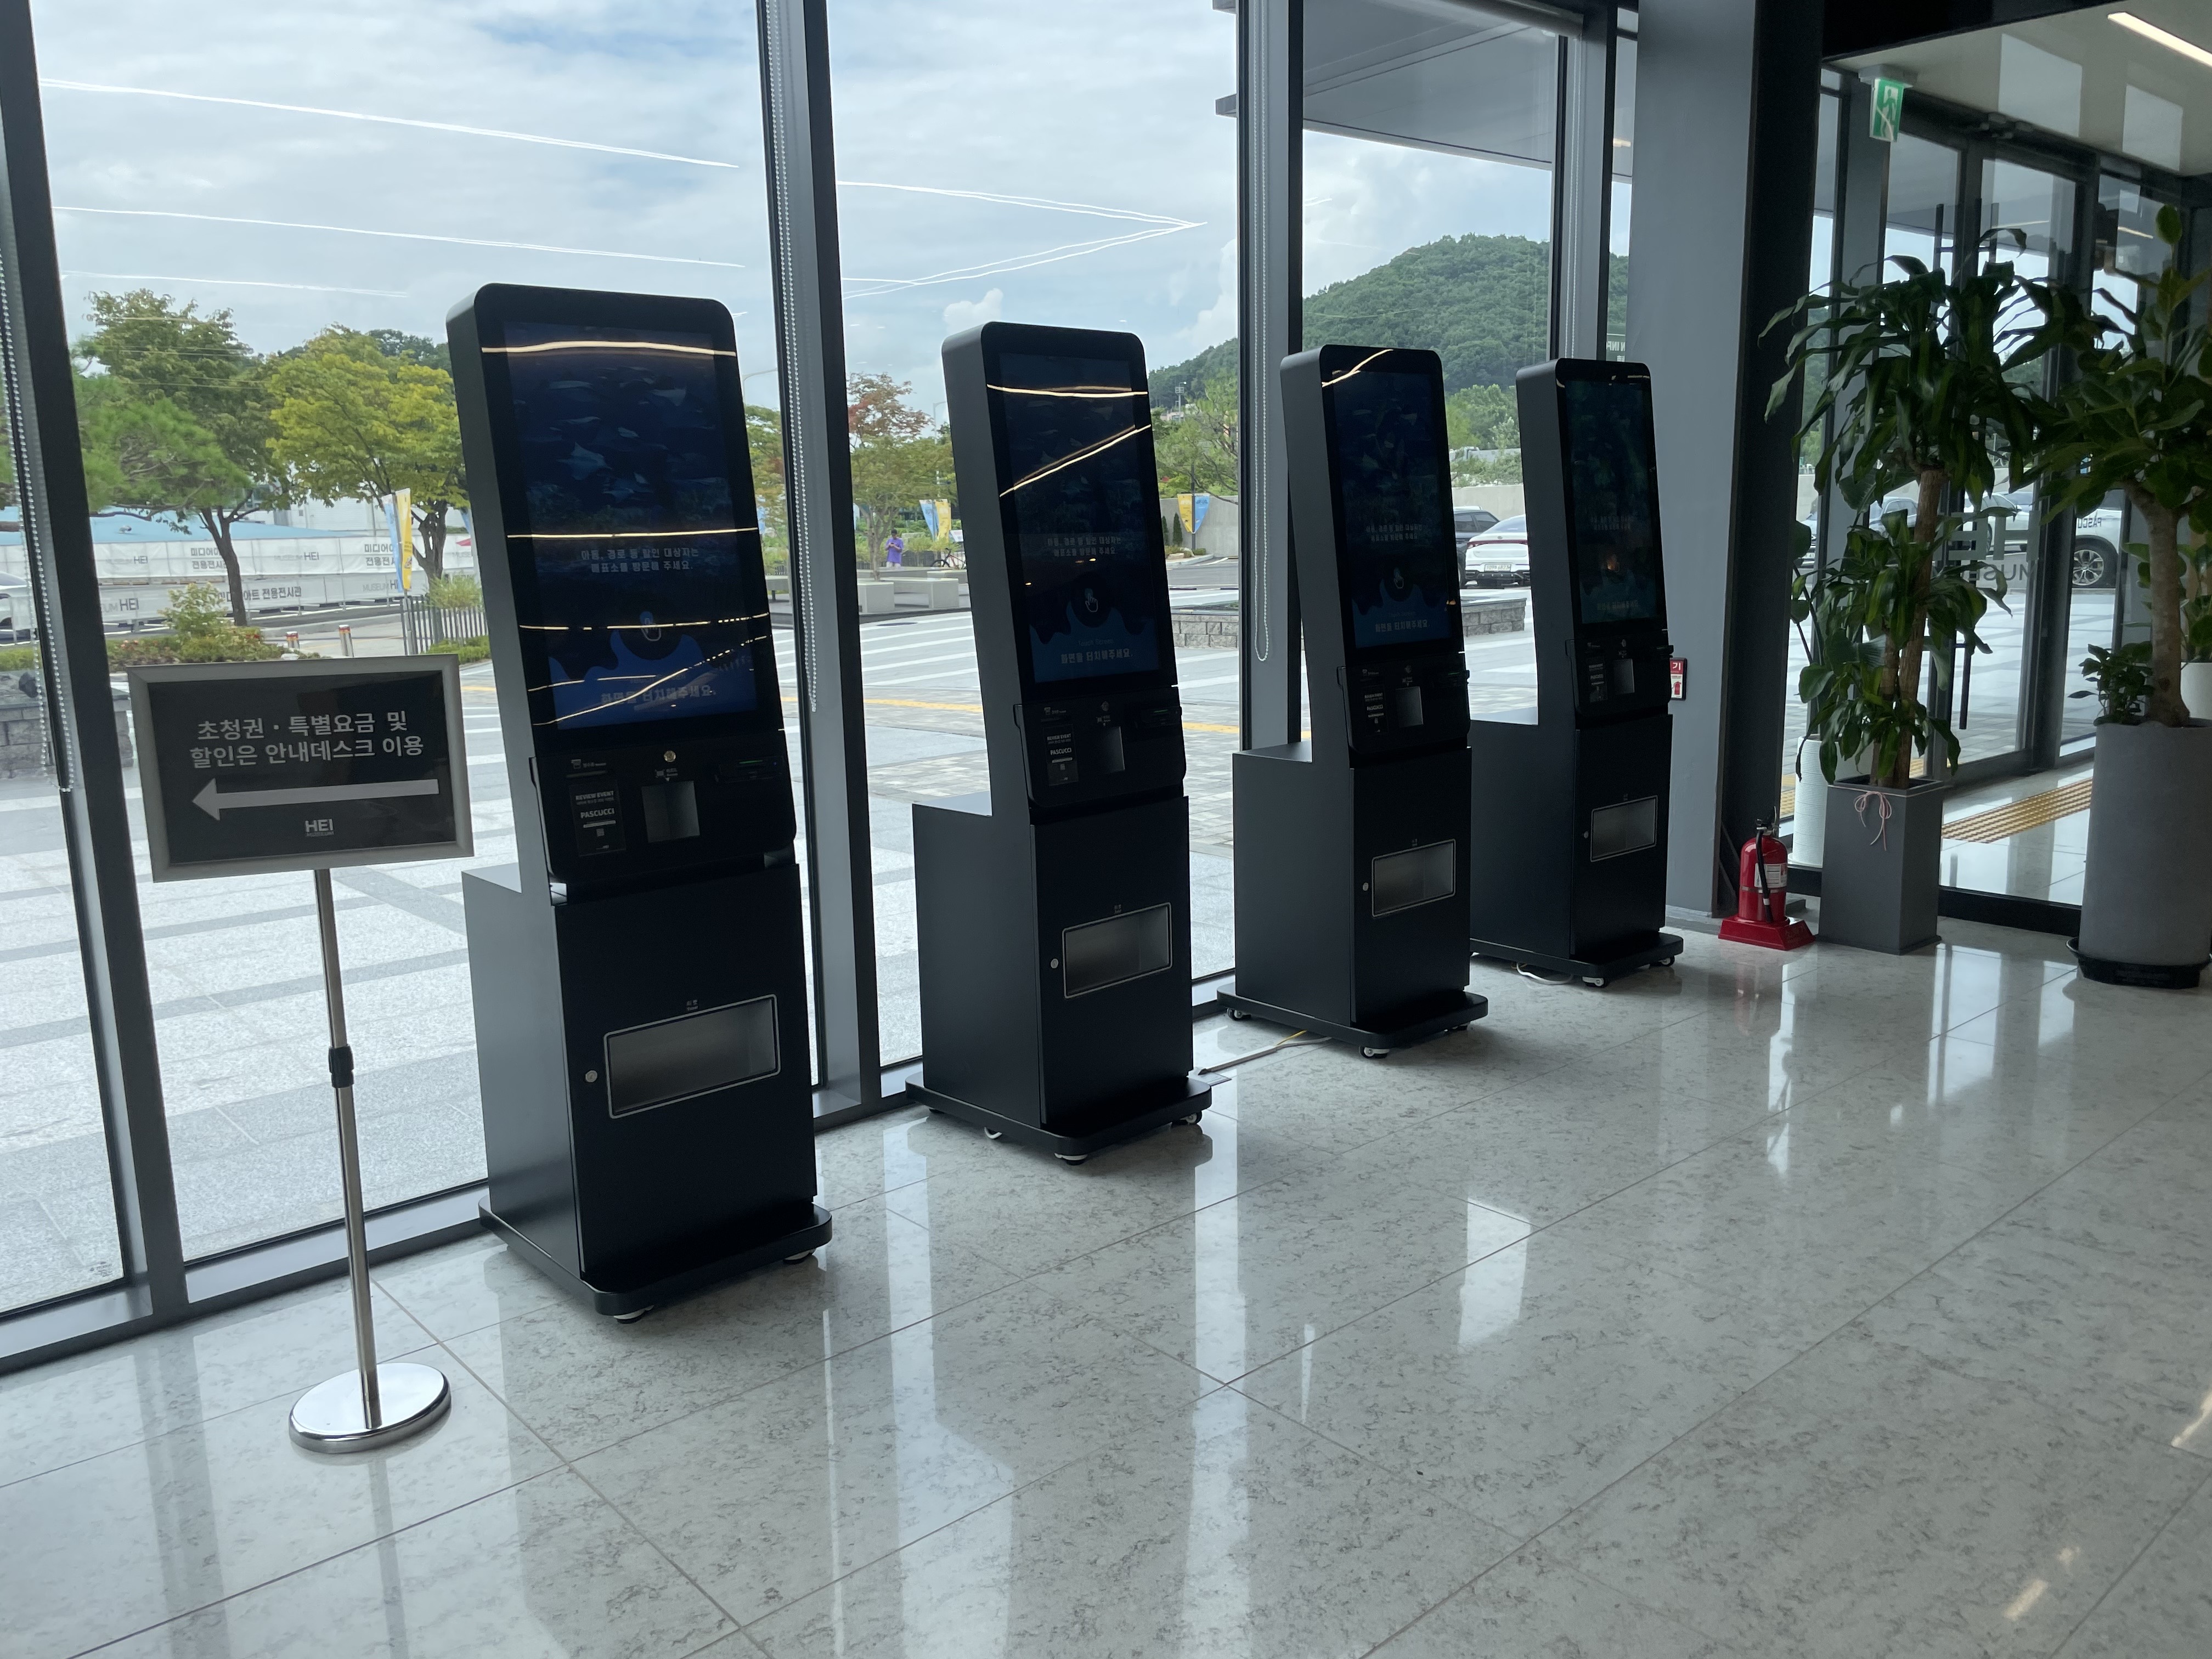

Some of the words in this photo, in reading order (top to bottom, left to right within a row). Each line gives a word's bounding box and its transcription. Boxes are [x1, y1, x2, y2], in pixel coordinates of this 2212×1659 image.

[303, 551, 320, 561] HEI
[262, 586, 302, 600] 전용전시관
[119, 597, 139, 612] HEI
[198, 718, 264, 740] 초청권
[288, 713, 376, 736] 특별요금
[387, 710, 407, 731] 및
[190, 745, 258, 769] 할인은
[265, 739, 376, 764] 안내데스크
[382, 735, 424, 757] 이용
[580, 807, 615, 819] PASCUCCI
[305, 819, 334, 833] HEI
